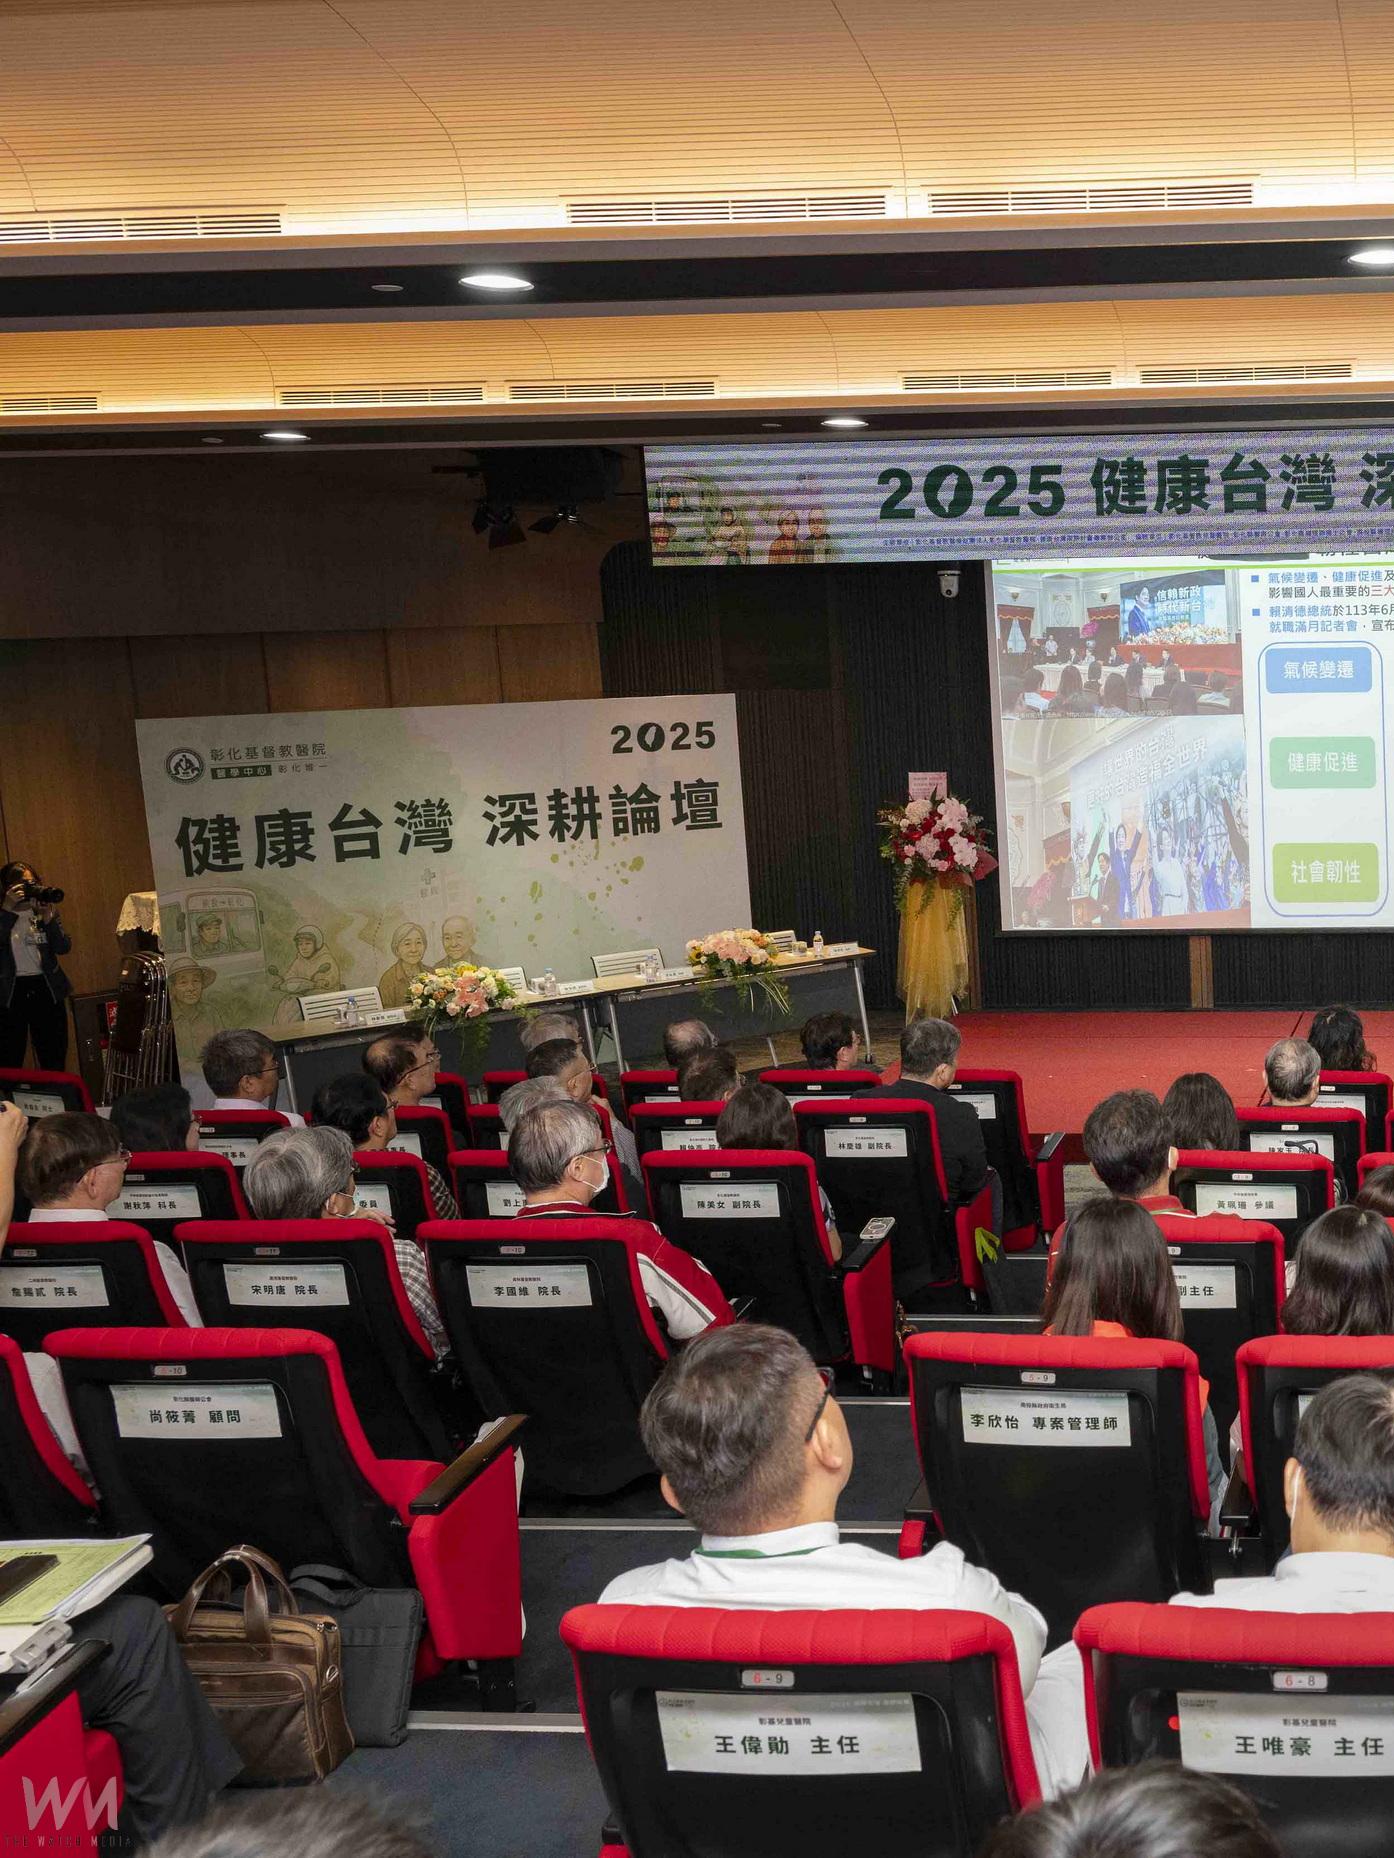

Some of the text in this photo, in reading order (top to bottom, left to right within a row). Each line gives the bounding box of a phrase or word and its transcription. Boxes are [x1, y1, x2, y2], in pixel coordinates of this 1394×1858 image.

[877, 464, 1065, 520] 2025
[1089, 453, 1338, 517] 健康台灣
[1284, 660, 1354, 680] 氣候變遷
[610, 720, 717, 755] 2025
[210, 743, 326, 762] 彰化基督教醫院
[1287, 751, 1360, 774] 健康促進
[175, 778, 724, 879] 健康台灣 深耕論壇
[1290, 860, 1362, 885] 社會韌性
[158, 1201, 177, 1210] 科長
[732, 1200, 761, 1209] 副院長
[54, 1286, 78, 1297] 院長
[294, 1284, 319, 1295] 院長
[537, 1285, 561, 1296] 院長
[208, 1409, 242, 1424] 顧問
[970, 1413, 1118, 1431] 李欣怡 專案管理師
[714, 1735, 860, 1755] 王偉勛 主任
[1235, 1736, 1385, 1756] 王唯豪 主任
